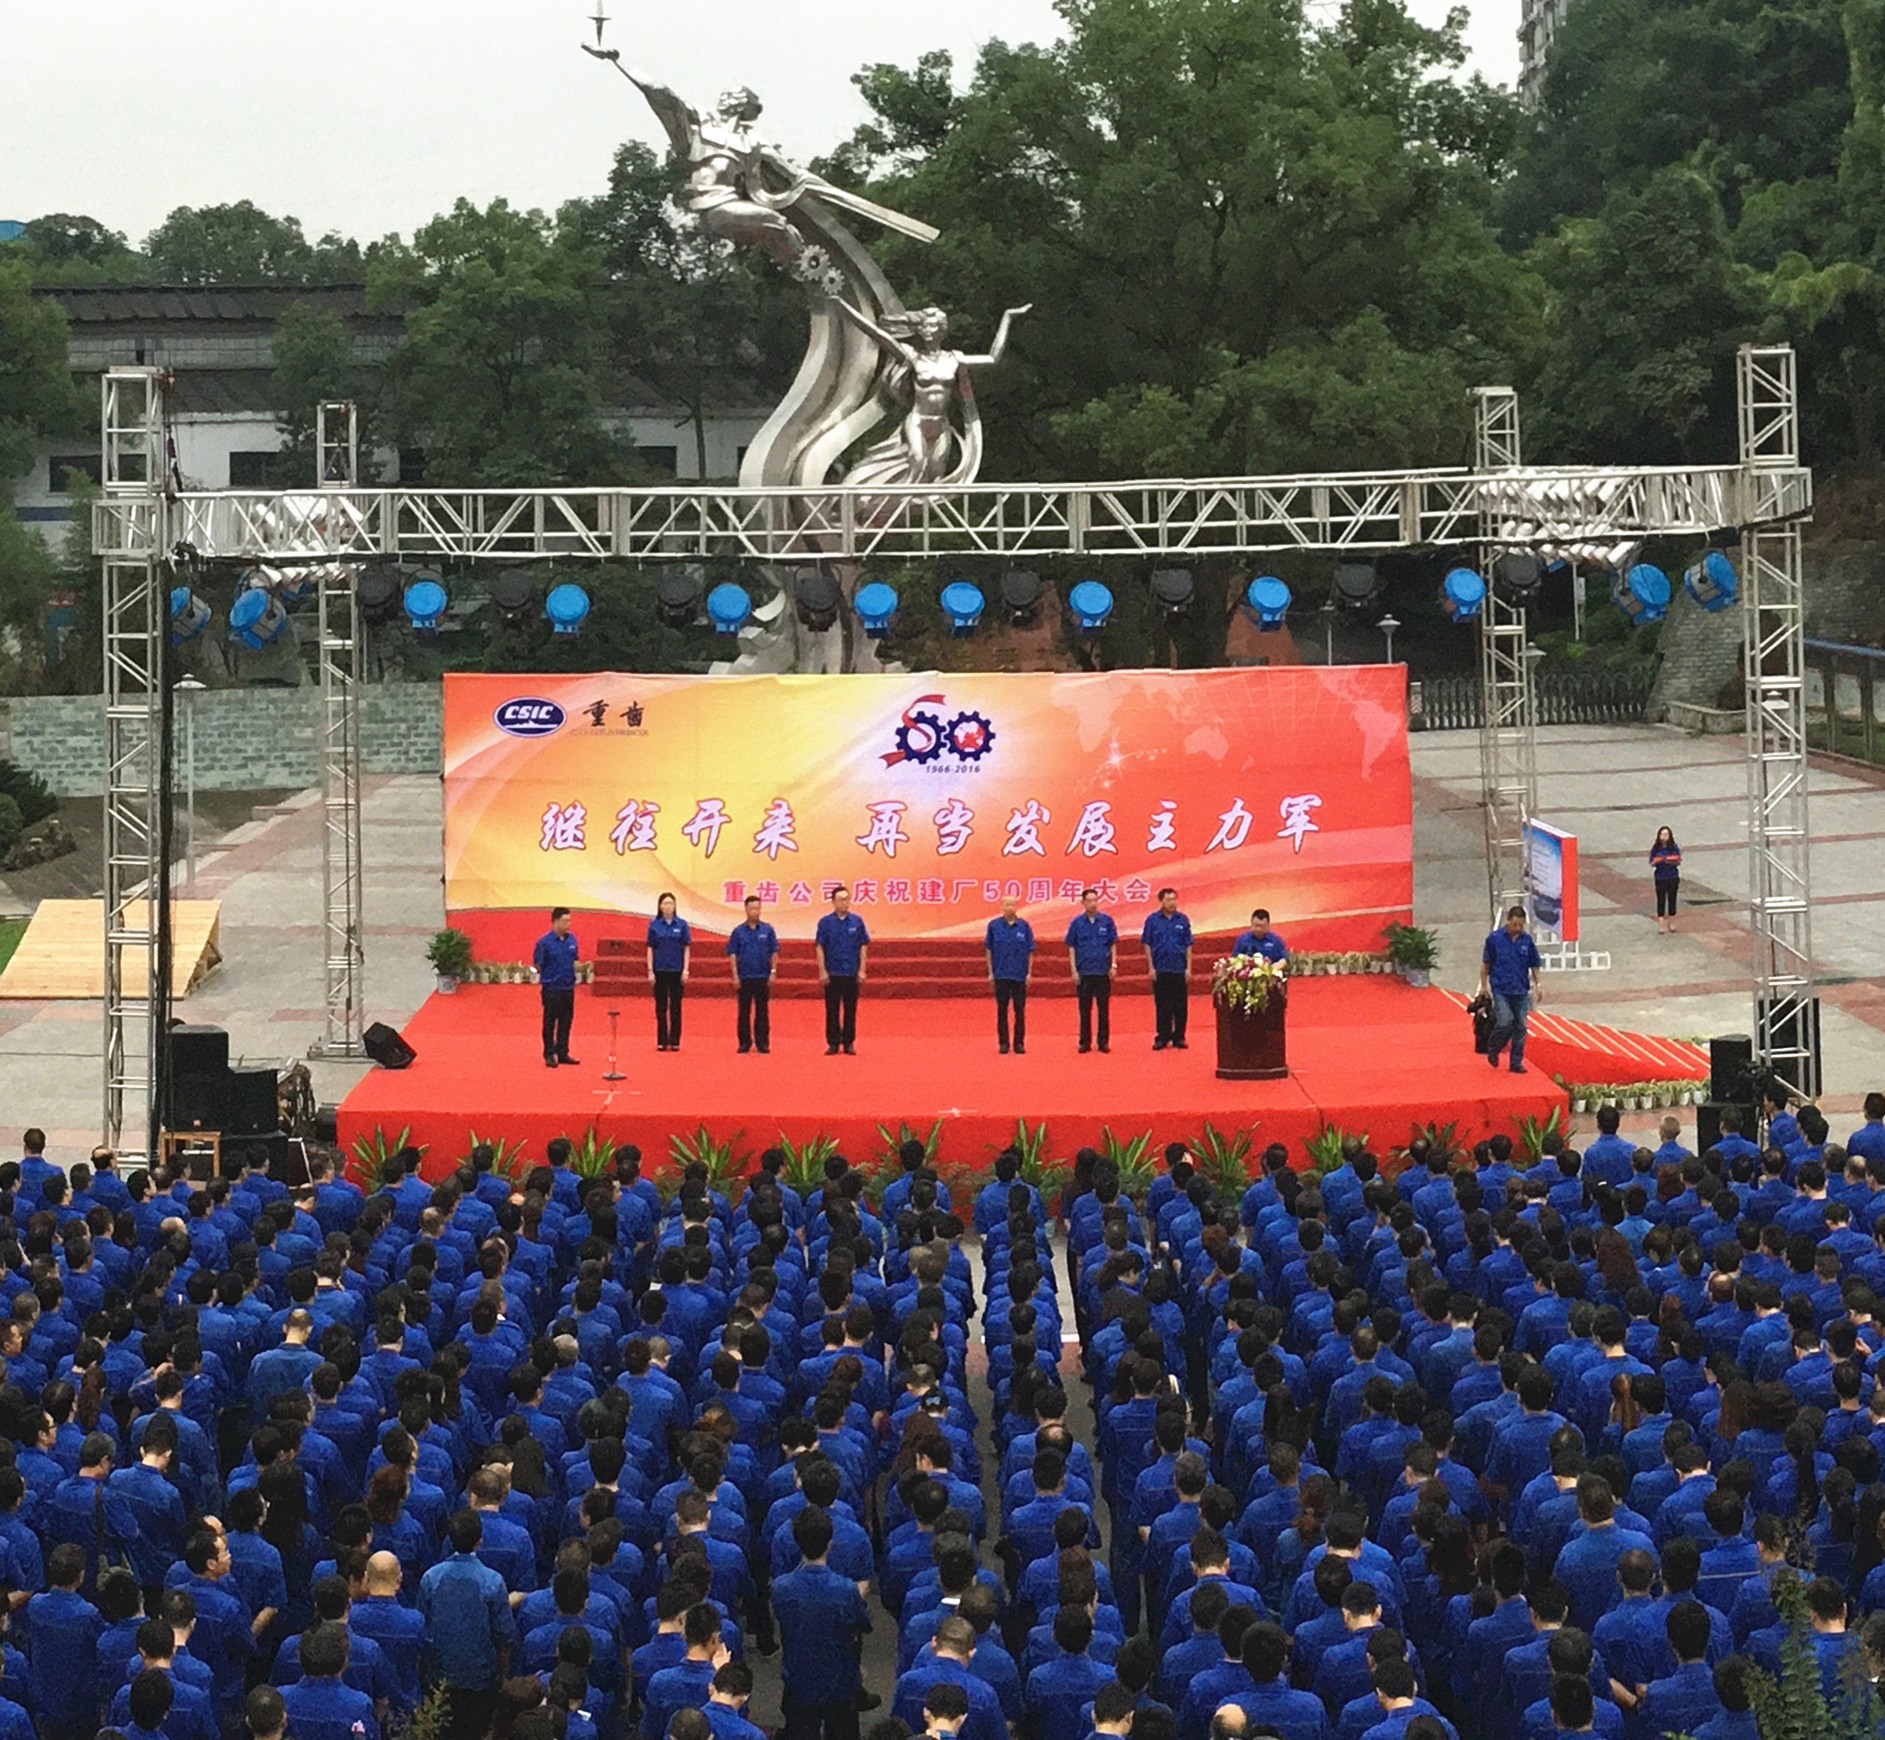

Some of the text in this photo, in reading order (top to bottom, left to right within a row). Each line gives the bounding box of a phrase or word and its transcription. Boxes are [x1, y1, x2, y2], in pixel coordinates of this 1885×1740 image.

[505, 705, 554, 719] CSIC
[582, 699, 645, 727] 重齿
[539, 794, 1323, 859] 继往开来 再当发展主力军
